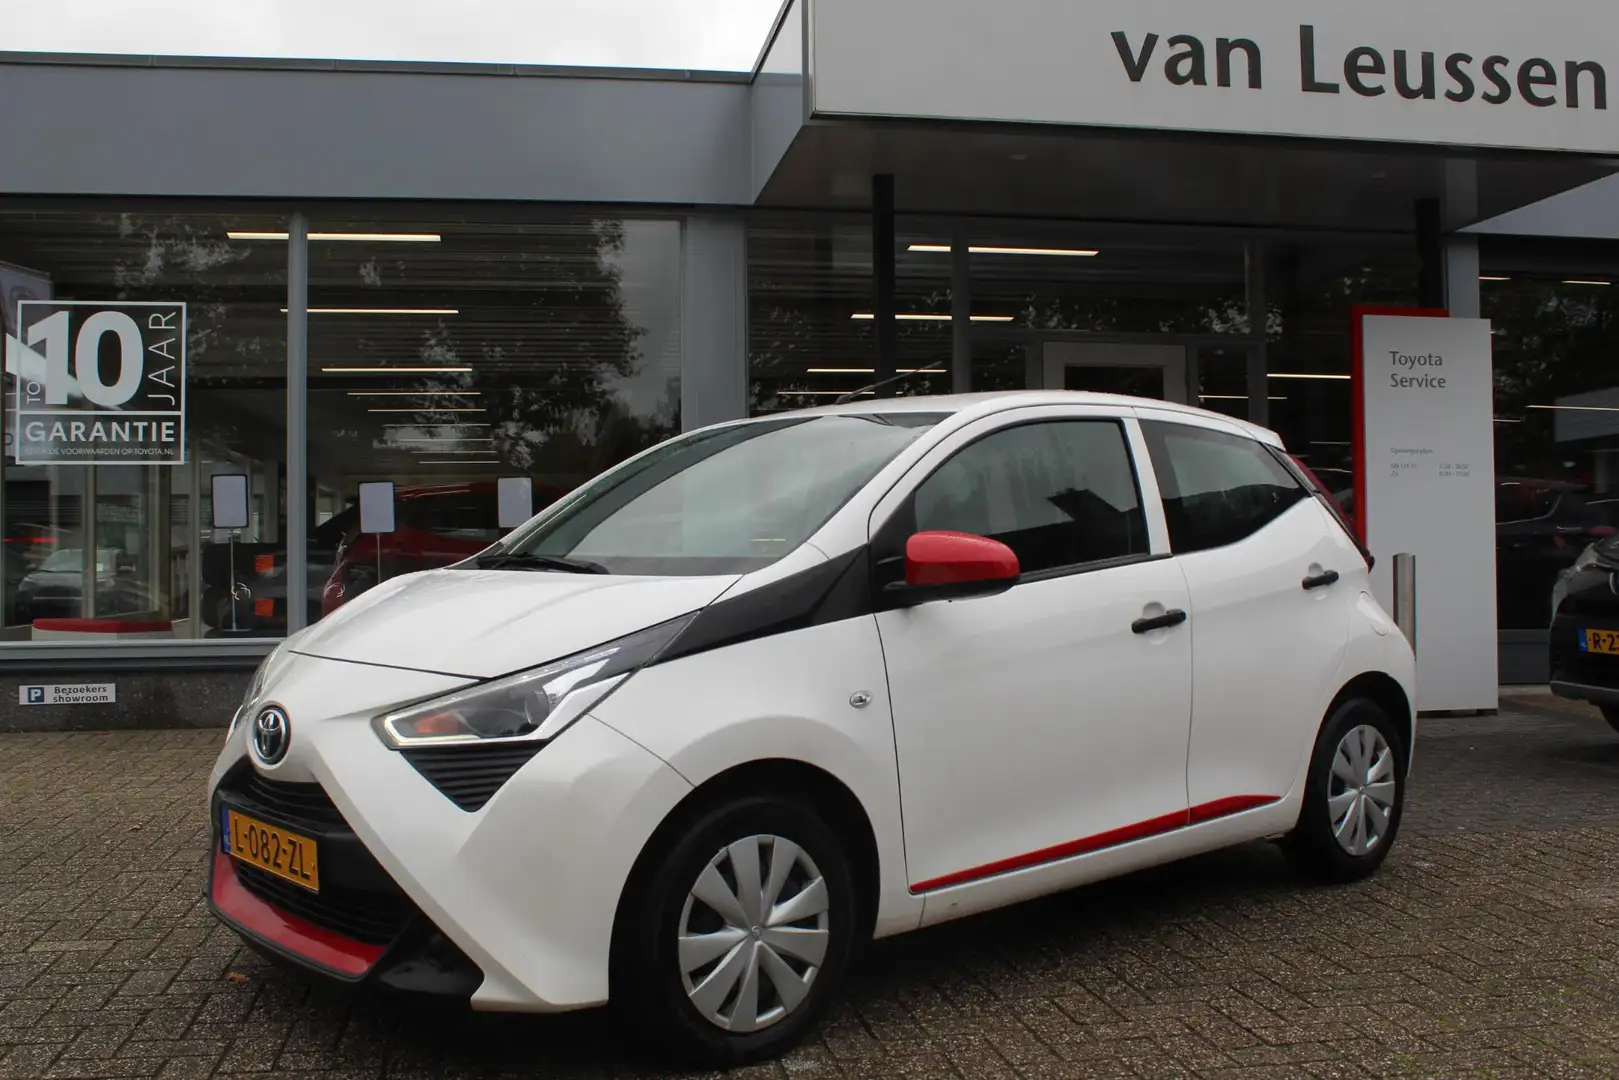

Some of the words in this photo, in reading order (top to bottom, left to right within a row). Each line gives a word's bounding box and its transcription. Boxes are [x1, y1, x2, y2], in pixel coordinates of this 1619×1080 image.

[1110, 31, 1262, 90] van
[1299, 24, 1607, 110] Leussen
[27, 310, 144, 407] 10
[147, 311, 176, 406] JAAR
[1389, 351, 1443, 370] Toyota
[26, 372, 41, 404] TO
[1390, 373, 1446, 388] Service
[25, 421, 175, 442] GARANTIE
[1592, 632, 1619, 651] R-2
[30, 688, 41, 701] P
[53, 694, 108, 703] showroom
[54, 686, 107, 694] Bezoekers
[234, 817, 311, 880] L-082-ZL
